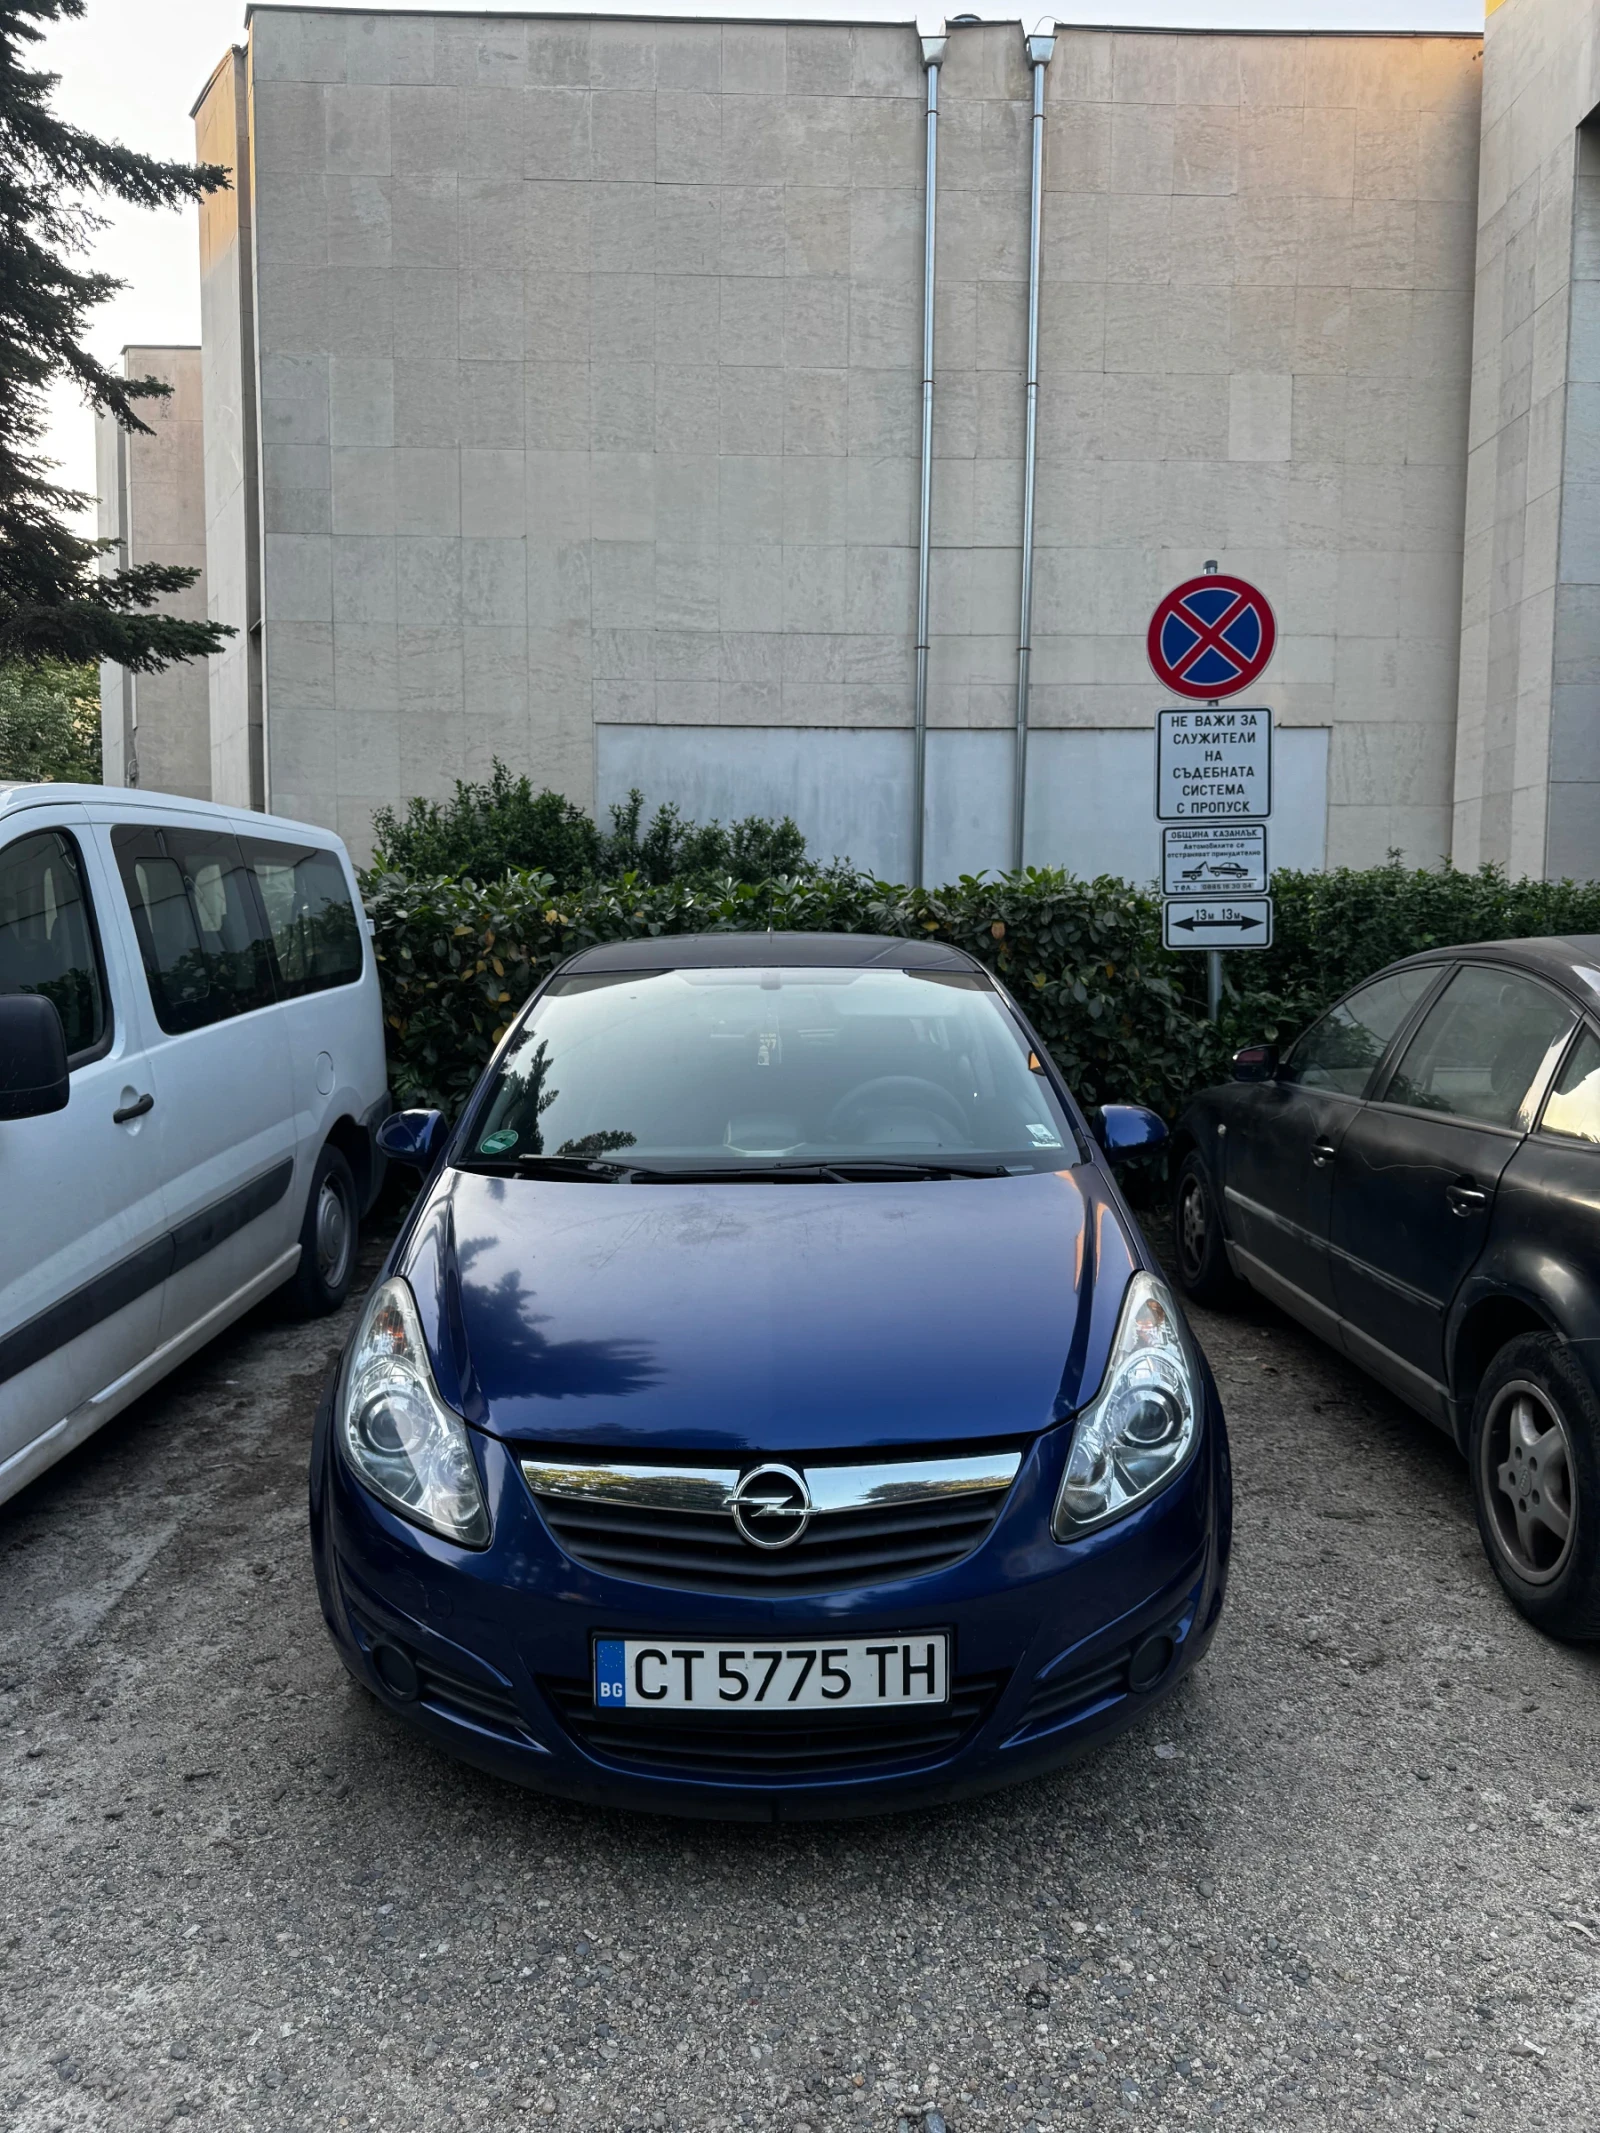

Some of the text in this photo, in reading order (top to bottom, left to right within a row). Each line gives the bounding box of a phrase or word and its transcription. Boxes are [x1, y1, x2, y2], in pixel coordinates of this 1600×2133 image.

[1171, 714, 1257, 727] НЕ ВАЖИ ЗА
[1173, 732, 1256, 745] СЛУЖИТЕЛИ
[1205, 750, 1223, 762] НА
[1172, 766, 1255, 780] СЪДЕБНАТА
[1182, 784, 1245, 796] СИСТЕМА
[1176, 801, 1250, 814] С ПРОПУСК
[1171, 829, 1258, 839] ОБЩИНА КАЗАНЛЪК
[1183, 842, 1234, 850] Автомобилите
[1211, 850, 1261, 858] принудително
[635, 1643, 935, 1701] CT 5775 TH
[600, 1681, 623, 1698] BG
